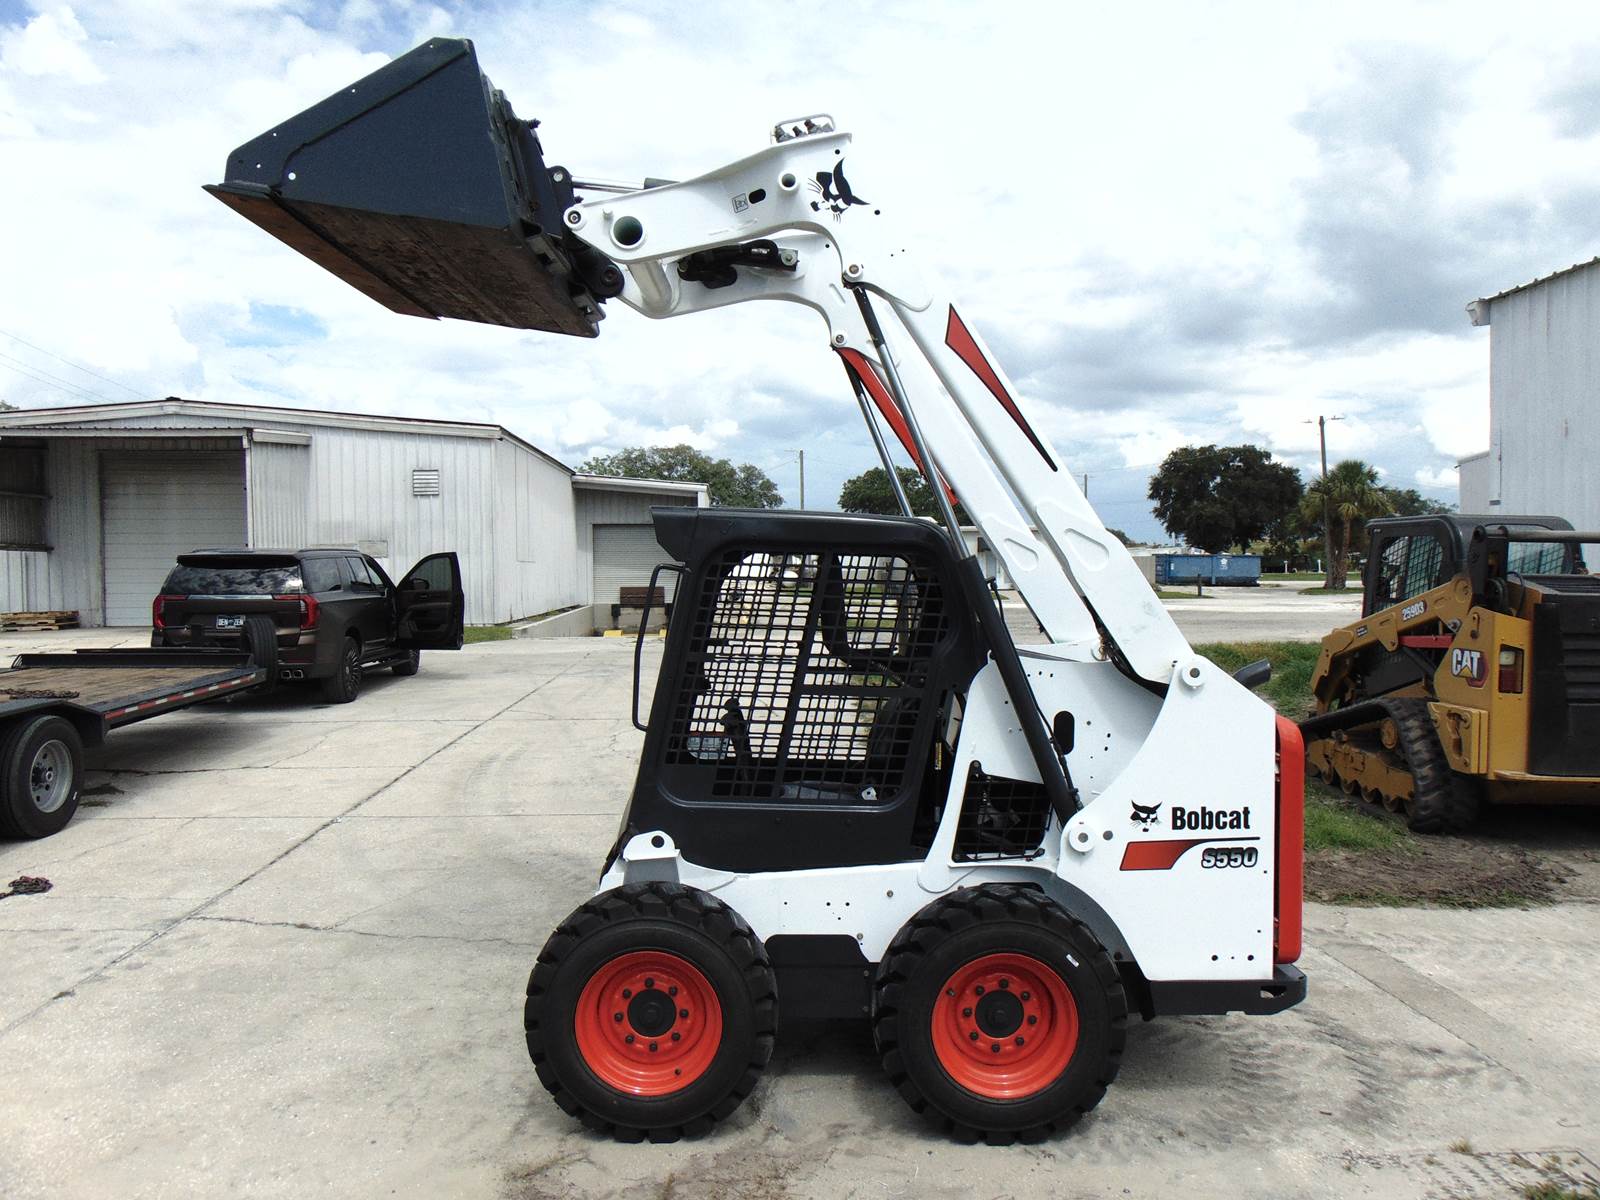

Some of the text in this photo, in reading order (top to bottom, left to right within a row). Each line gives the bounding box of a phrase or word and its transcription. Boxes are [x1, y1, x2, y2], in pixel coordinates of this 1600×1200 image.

[1452, 649, 1480, 678] CAT
[1171, 806, 1250, 830] Bobcat
[1201, 847, 1258, 868] S550
